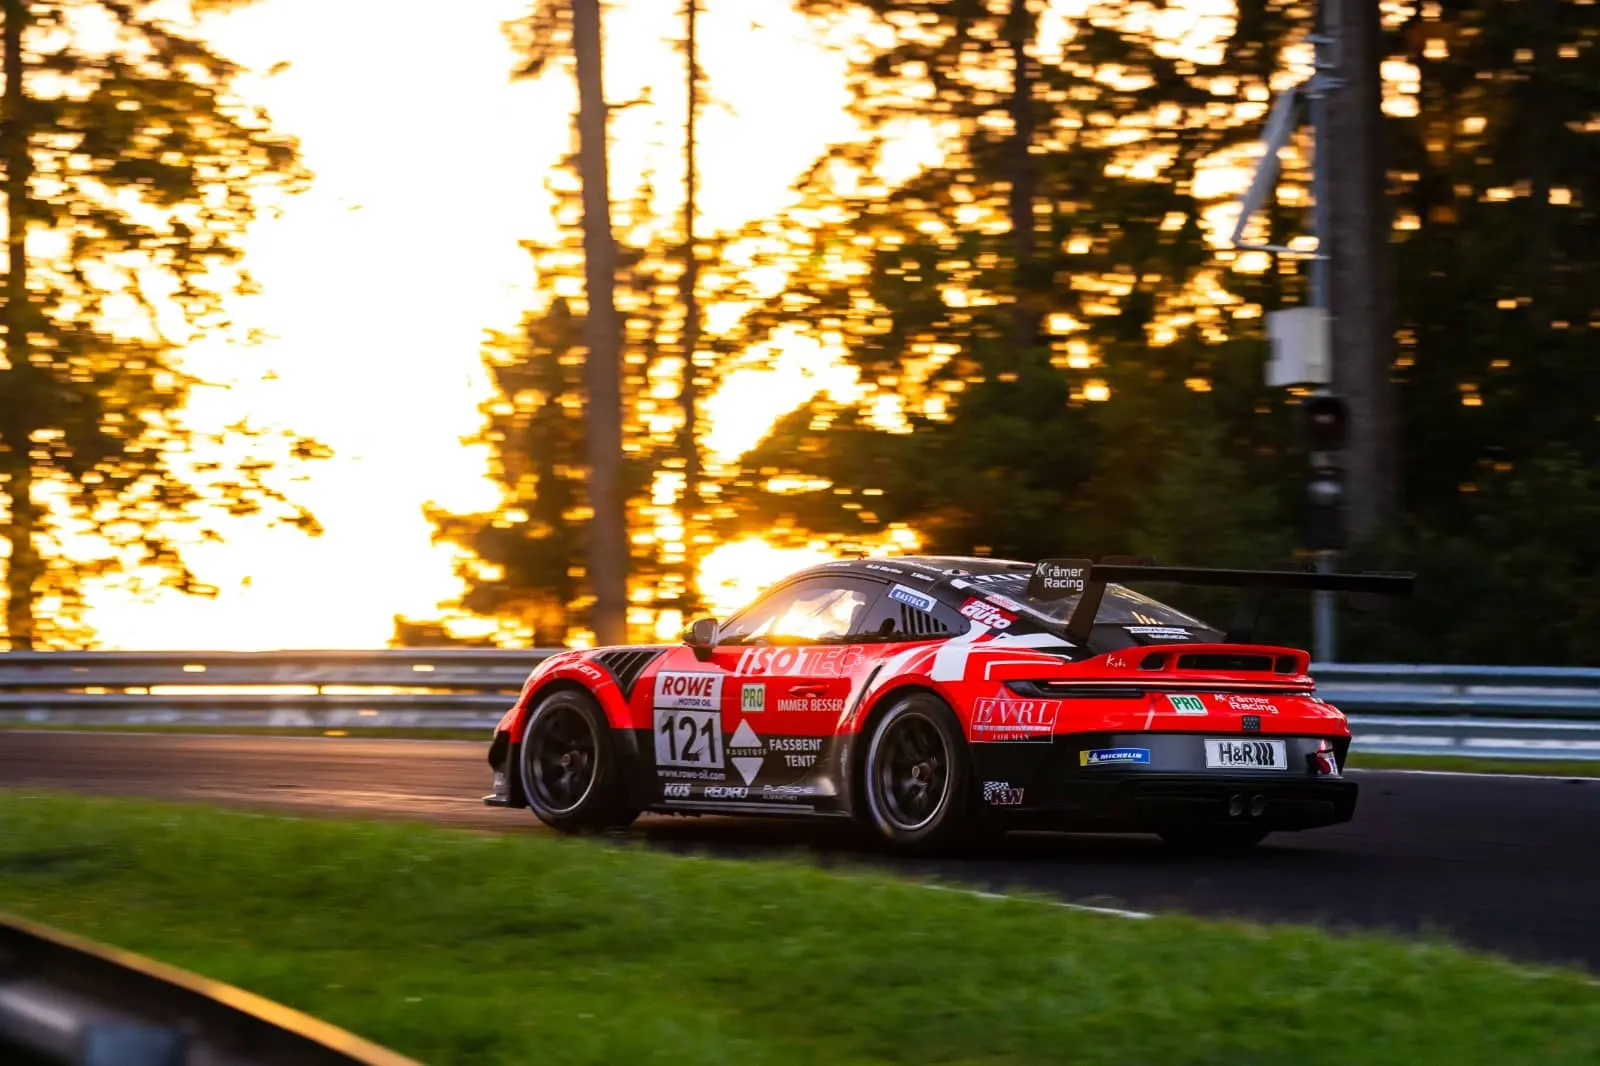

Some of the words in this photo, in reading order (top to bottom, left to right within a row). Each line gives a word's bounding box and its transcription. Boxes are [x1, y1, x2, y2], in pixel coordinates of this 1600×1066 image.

[1036, 562, 1084, 577] Krämer
[1043, 577, 1084, 591] Racing
[661, 676, 716, 697] ROWE
[743, 687, 764, 708] PRO
[1170, 696, 1205, 711] PRO
[777, 699, 808, 712] IMMER
[811, 699, 844, 713] BESSER
[1228, 702, 1280, 715] Racing
[661, 715, 717, 763] 121
[1100, 752, 1143, 760] MICHELIN
